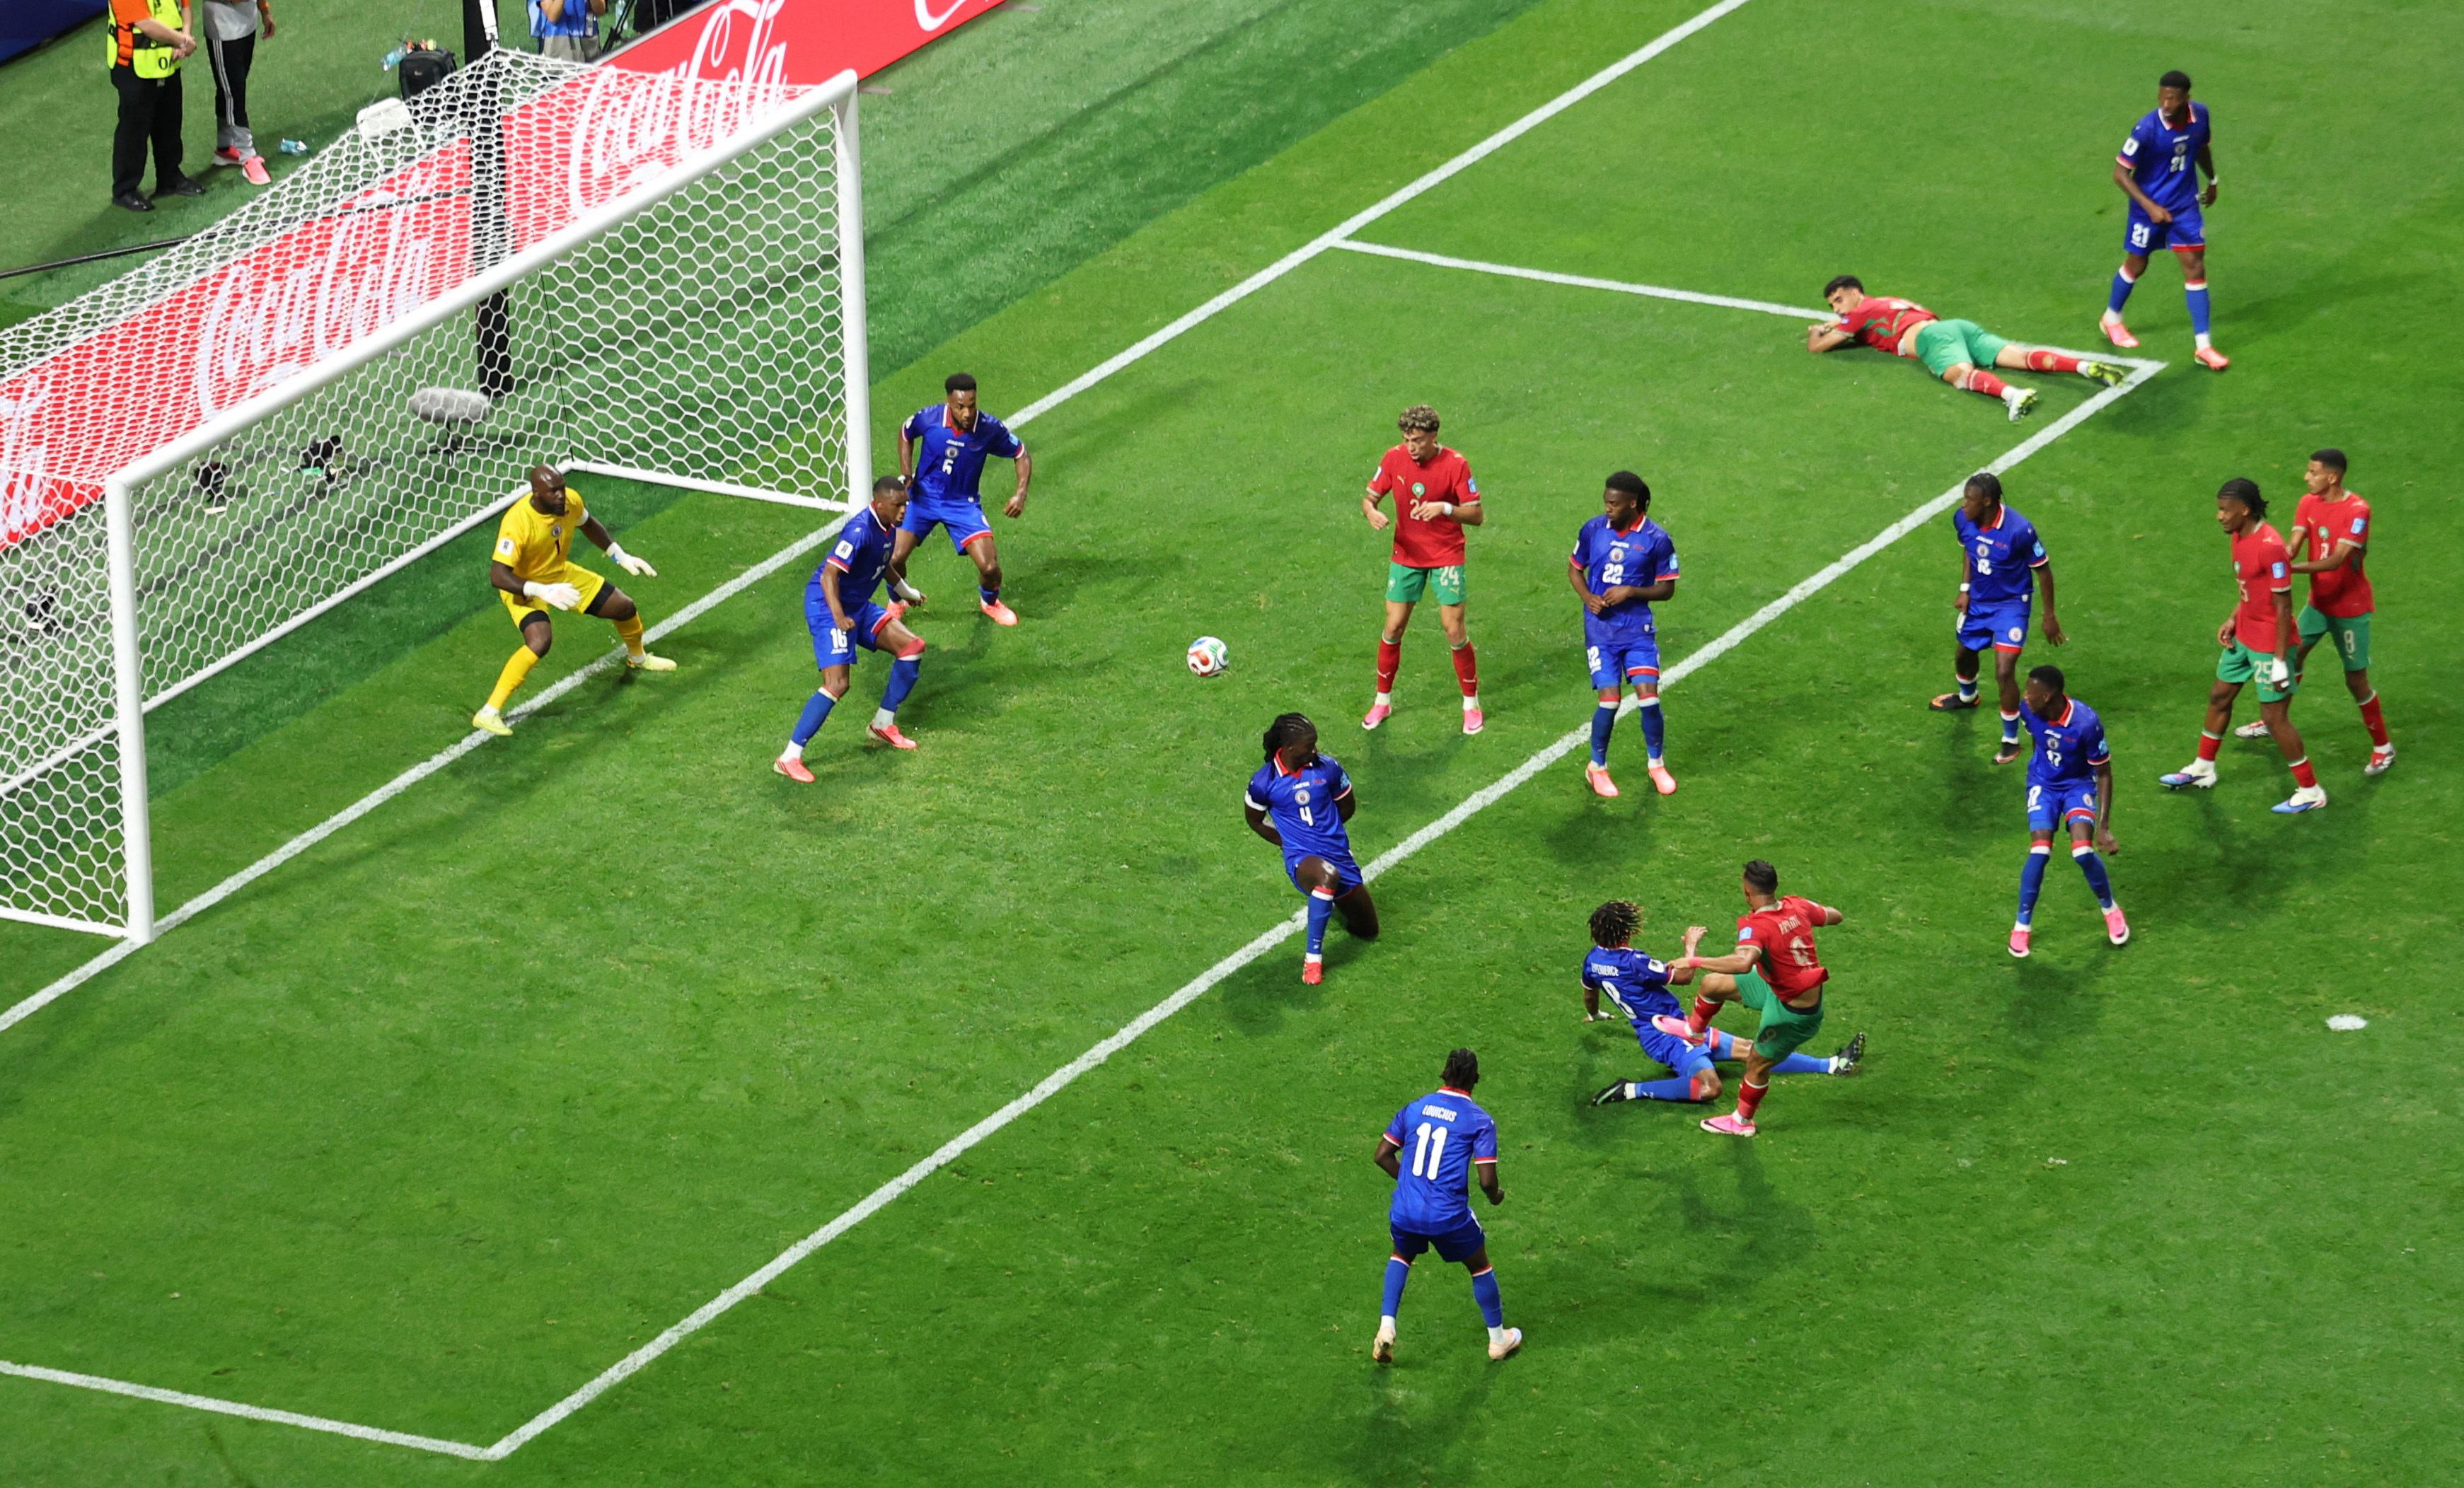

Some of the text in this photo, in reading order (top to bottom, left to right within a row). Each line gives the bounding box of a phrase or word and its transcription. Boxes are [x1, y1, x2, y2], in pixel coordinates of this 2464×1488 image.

[2170, 154, 2186, 173] 21
[2131, 223, 2150, 245] 21
[942, 458, 954, 475] 5
[555, 539, 560, 555] 1
[1439, 565, 1460, 586] 24
[1602, 563, 1624, 585] 22
[830, 627, 848, 649] 16
[2254, 661, 2273, 684] 25
[1299, 806, 1314, 826] 4
[1602, 980, 1638, 1019] 8
[1421, 1104, 1457, 1123] LOUICIUS
[1412, 1122, 1447, 1180] 11
